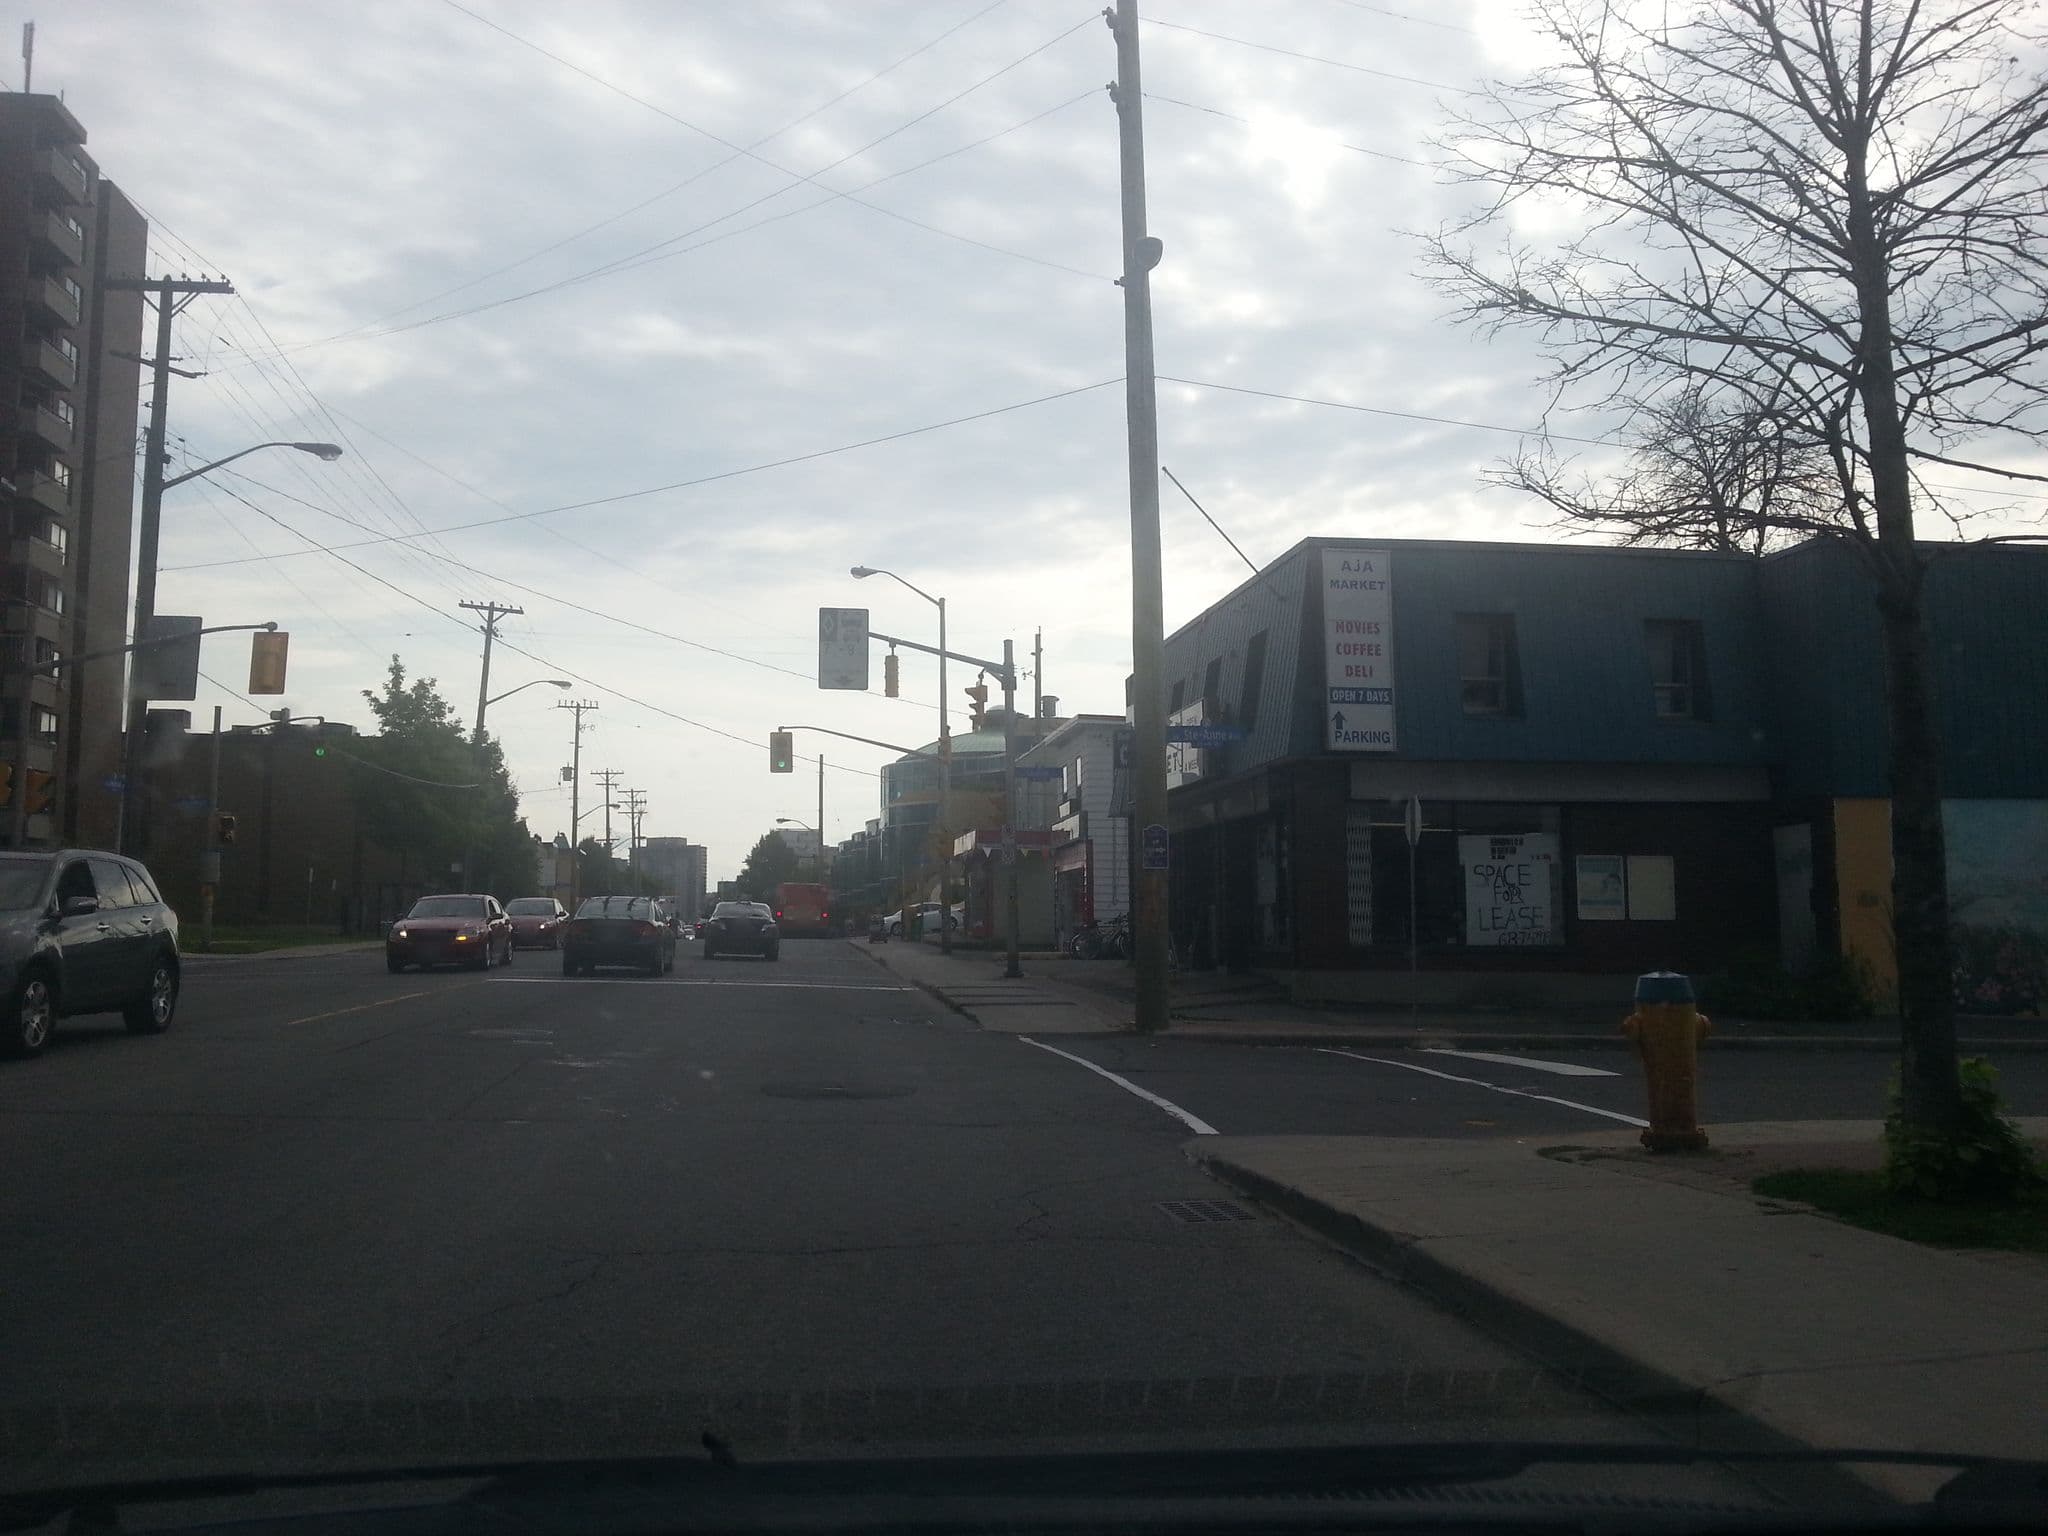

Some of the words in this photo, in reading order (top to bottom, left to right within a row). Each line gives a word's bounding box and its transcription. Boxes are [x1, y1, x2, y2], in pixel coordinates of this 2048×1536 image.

[1341, 560, 1374, 573] AJA
[1330, 579, 1386, 591] MARKET
[1335, 621, 1381, 636] MOVIES
[1335, 643, 1382, 657] COFFEE
[1345, 665, 1374, 678] DELI
[1332, 690, 1356, 701] OPEN
[1358, 690, 1364, 701] 7
[1366, 690, 1390, 702] DAYS
[1335, 730, 1391, 744] PARKING
[1473, 864, 1531, 887] SPACE
[1493, 885, 1525, 904] FOR
[1479, 906, 1544, 931] LEASE
